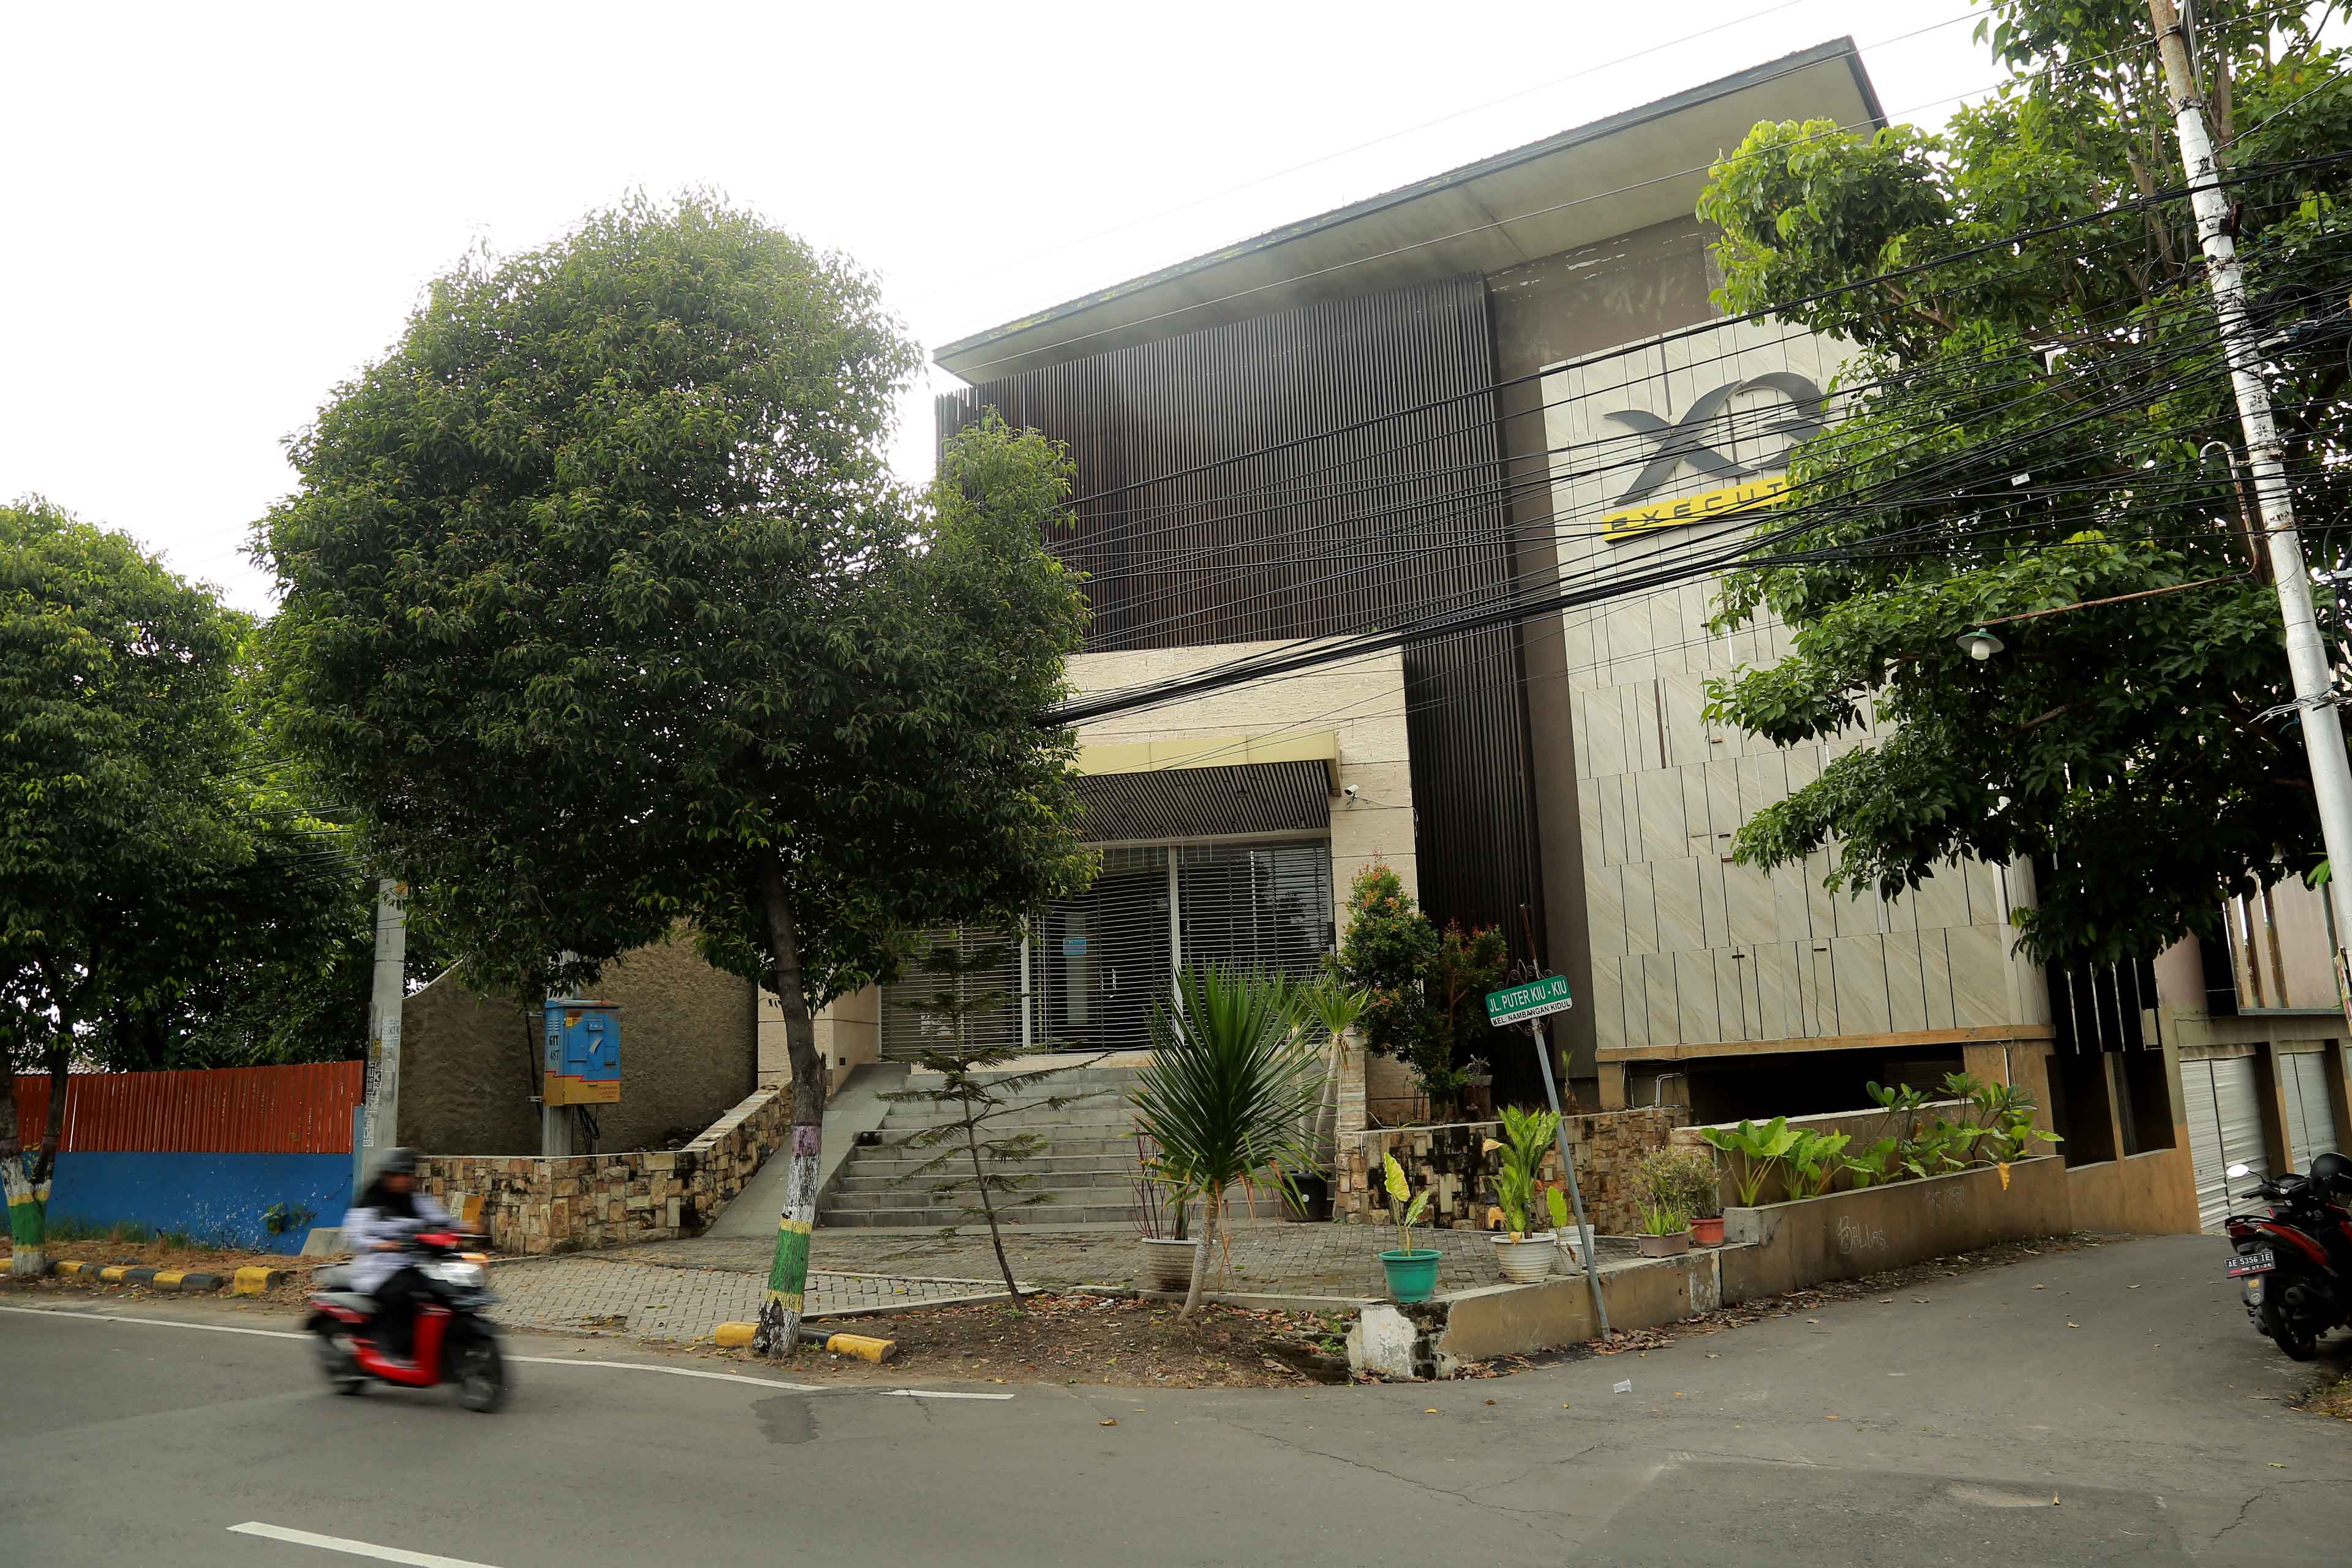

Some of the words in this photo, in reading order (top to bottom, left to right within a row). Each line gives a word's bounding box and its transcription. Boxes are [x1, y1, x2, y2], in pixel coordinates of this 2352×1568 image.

[1490, 998, 1502, 1012] JL.
[1501, 989, 1531, 1009] PUTER
[1530, 985, 1547, 1001] KIU
[1551, 979, 1567, 997] KIU
[1508, 1006, 1550, 1021] NAMBANGAN
[1550, 1000, 1571, 1011] KIDUL
[2239, 1256, 2258, 1265] 5356
